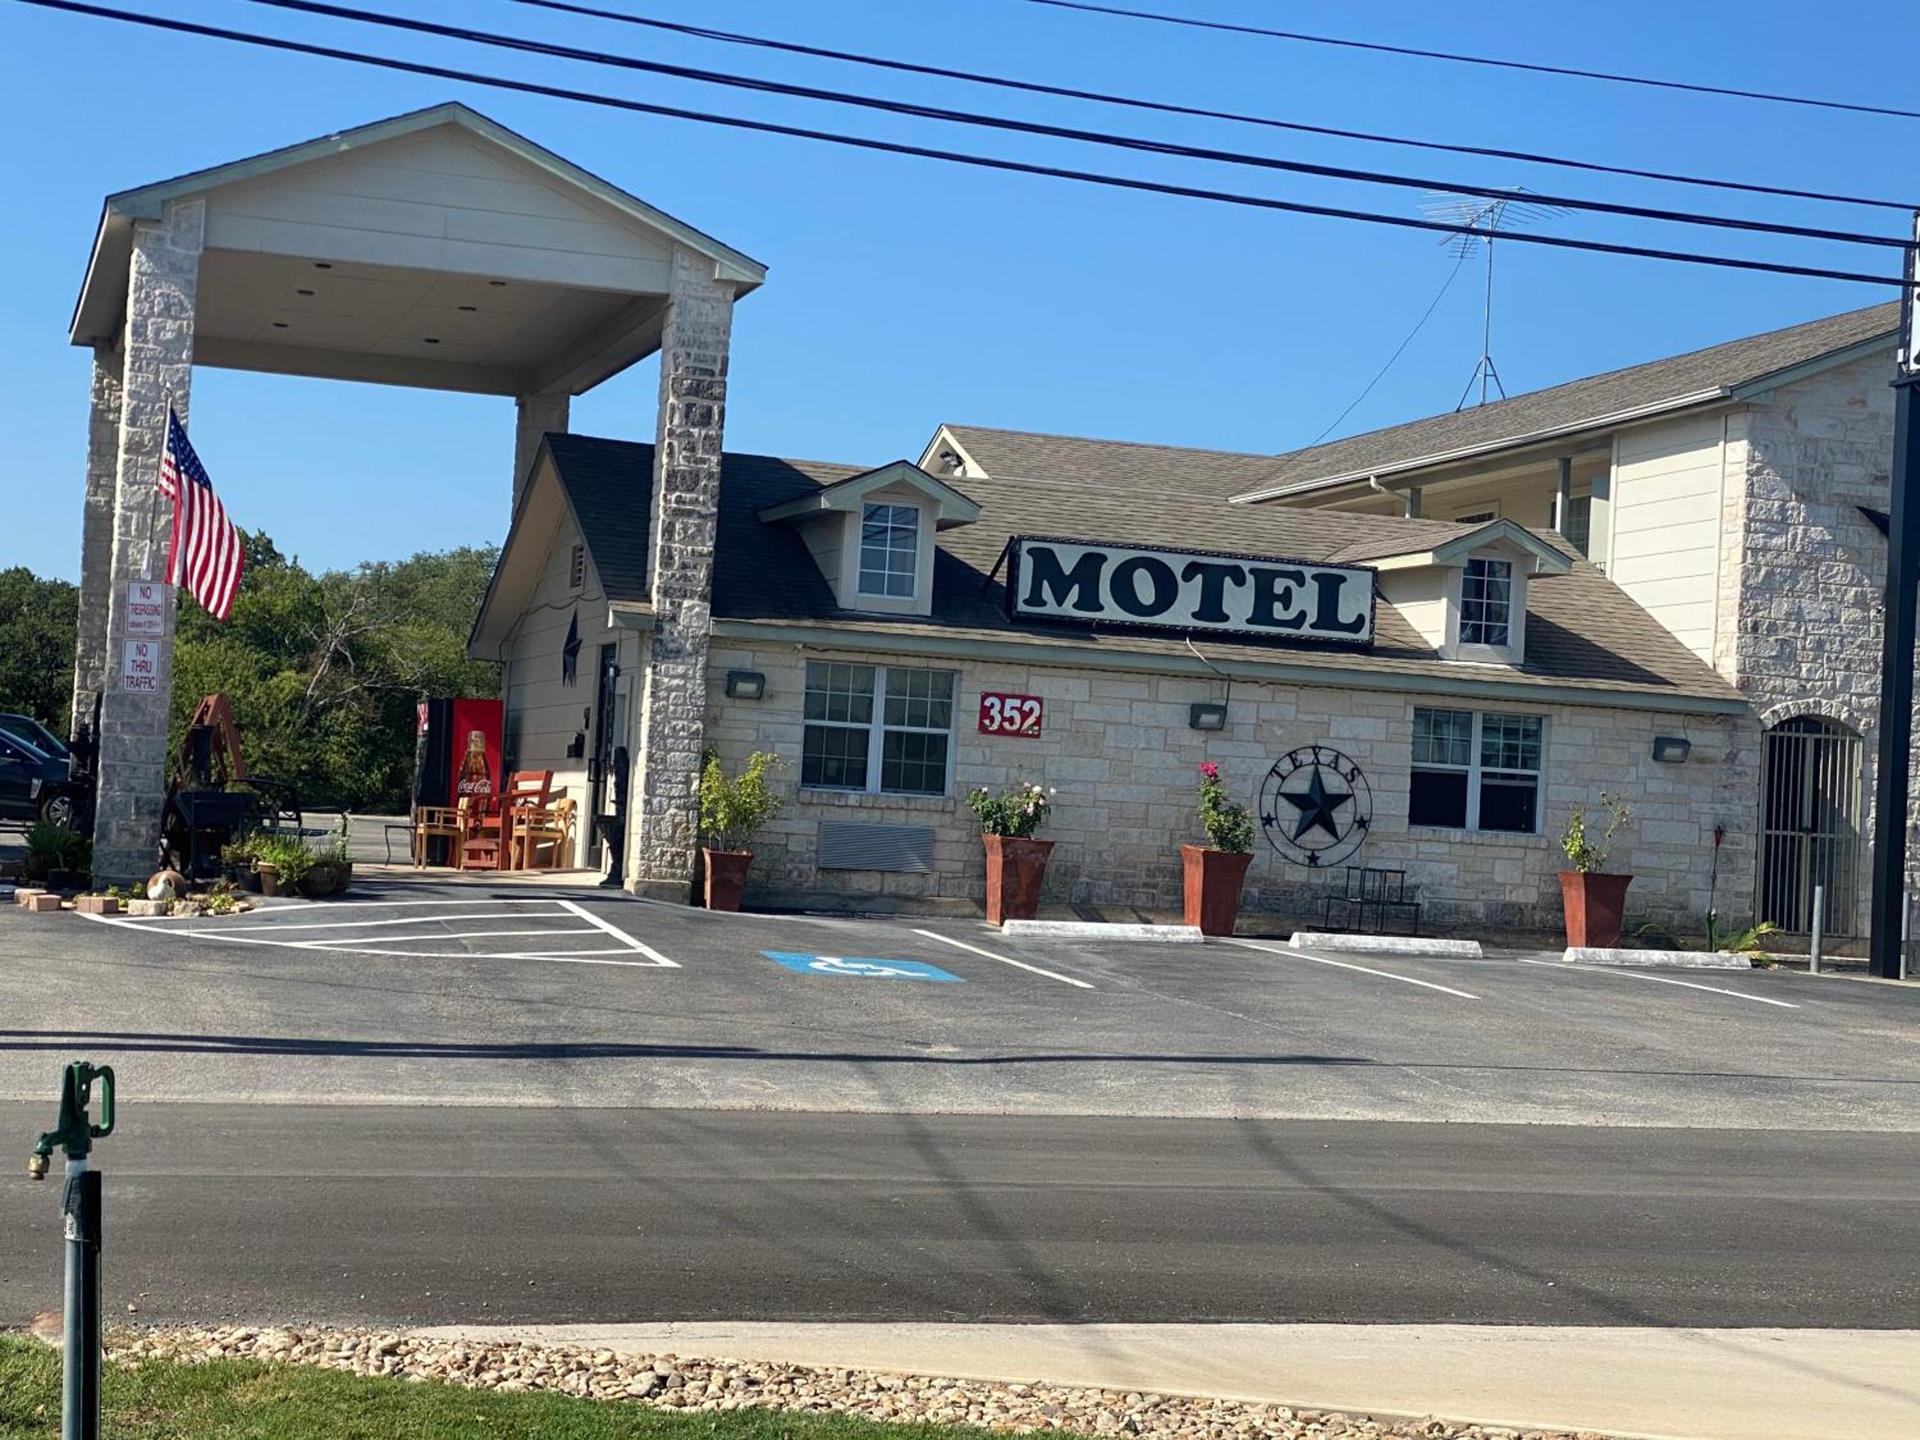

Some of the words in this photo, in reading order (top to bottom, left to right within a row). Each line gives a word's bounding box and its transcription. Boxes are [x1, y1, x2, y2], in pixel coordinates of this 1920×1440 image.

[140, 586, 152, 599] NO
[1023, 547, 1365, 634] MOTEL
[135, 643, 148, 657] NO
[131, 659, 152, 673] THRU
[126, 675, 156, 690] TRAFFIC
[983, 696, 1041, 734] 352
[1269, 746, 1362, 784] TEXAS
